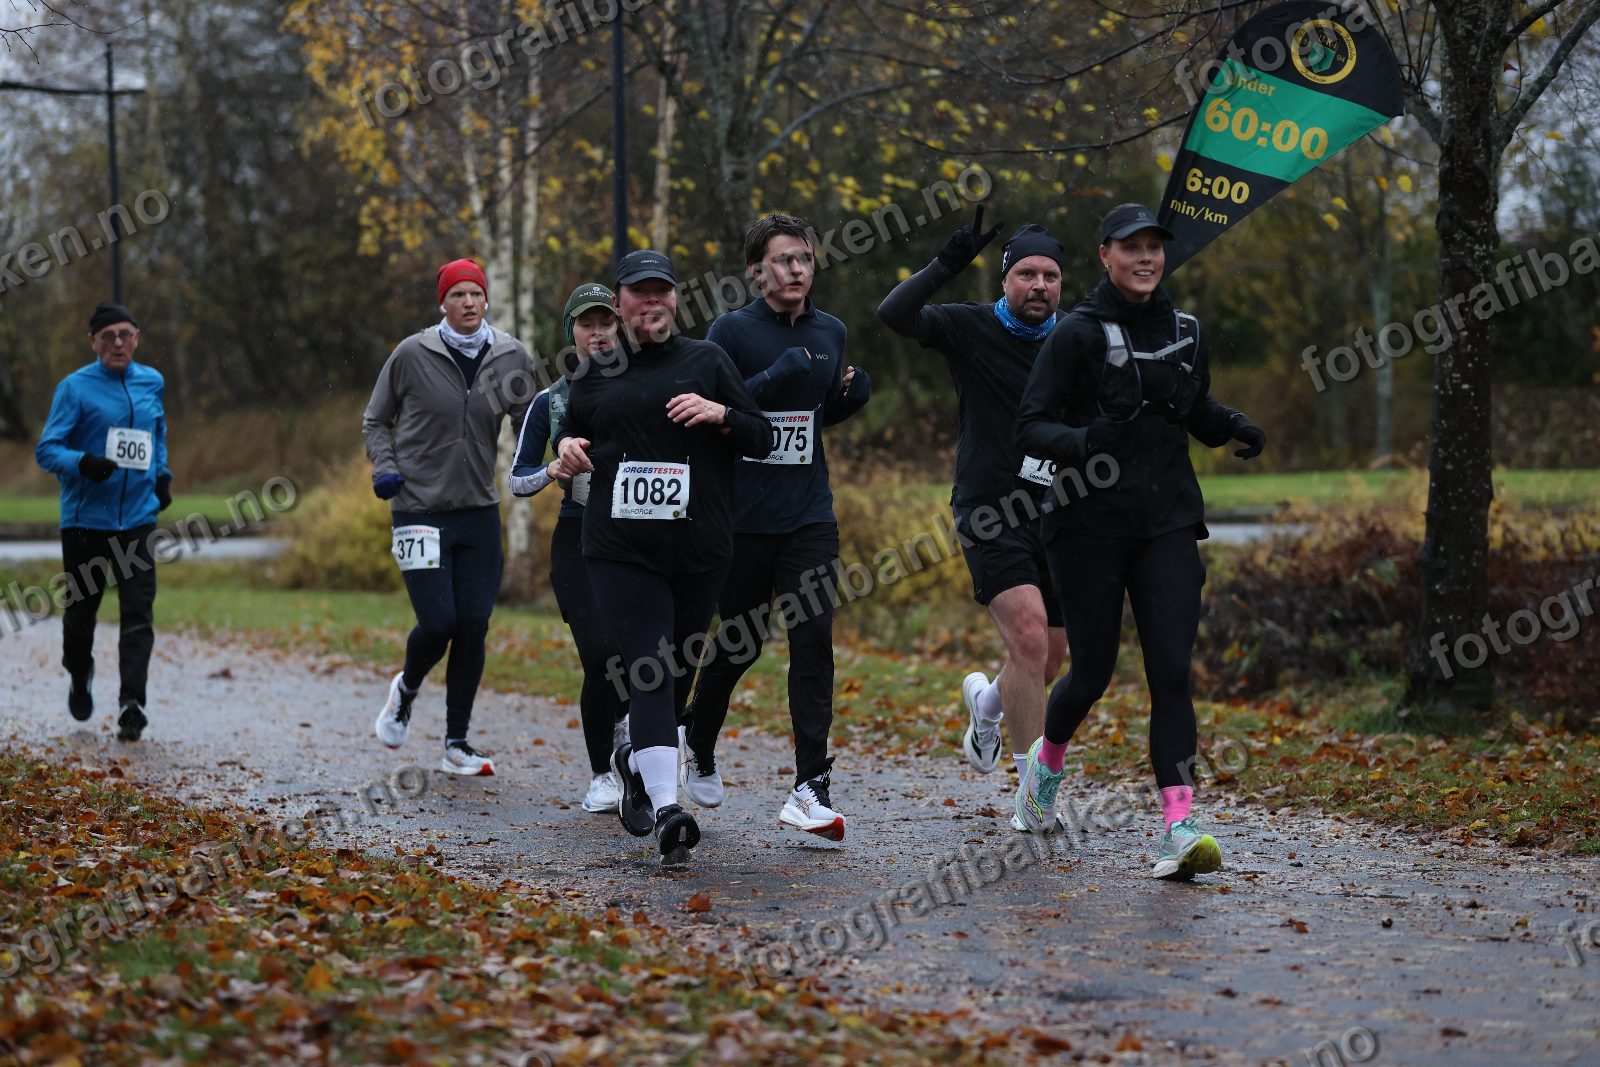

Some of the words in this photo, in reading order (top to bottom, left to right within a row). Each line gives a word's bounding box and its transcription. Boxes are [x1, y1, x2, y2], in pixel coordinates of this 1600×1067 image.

[1204, 97, 1329, 160] 60:00
[1185, 167, 1250, 204] 6:00
[1170, 199, 1229, 225] min/km
[116, 440, 146, 461] 506
[621, 477, 682, 506] 1082
[397, 537, 425, 560] 371
